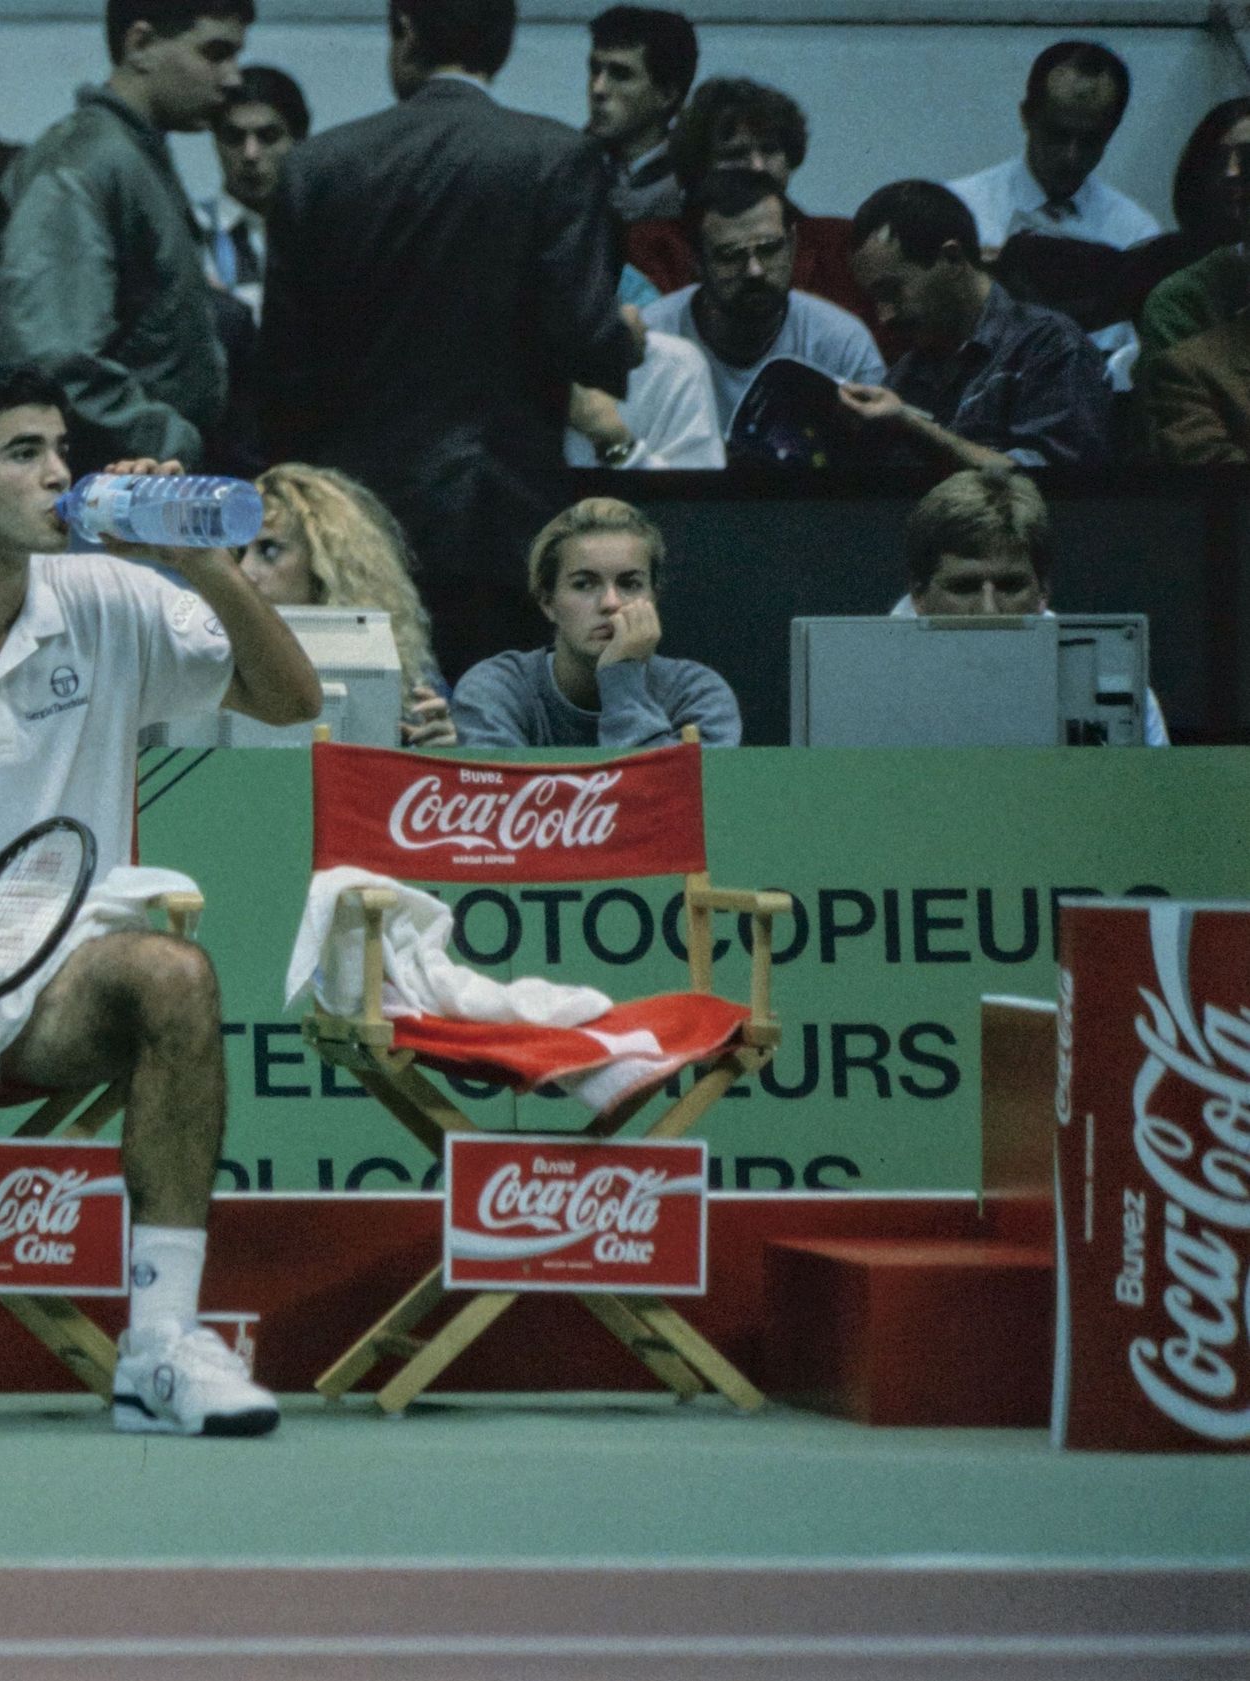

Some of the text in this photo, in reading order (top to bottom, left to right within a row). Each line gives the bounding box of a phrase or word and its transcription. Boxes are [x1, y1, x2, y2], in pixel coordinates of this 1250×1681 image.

[459, 768, 504, 785] Buvez
[389, 770, 623, 851] Coca-Cola
[533, 1156, 577, 1176] Buvez
[477, 1162, 668, 1234] Coca-Cola
[14, 1232, 78, 1266] Coke
[593, 1231, 656, 1265] Coke
[1116, 1187, 1146, 1307] Buvez
